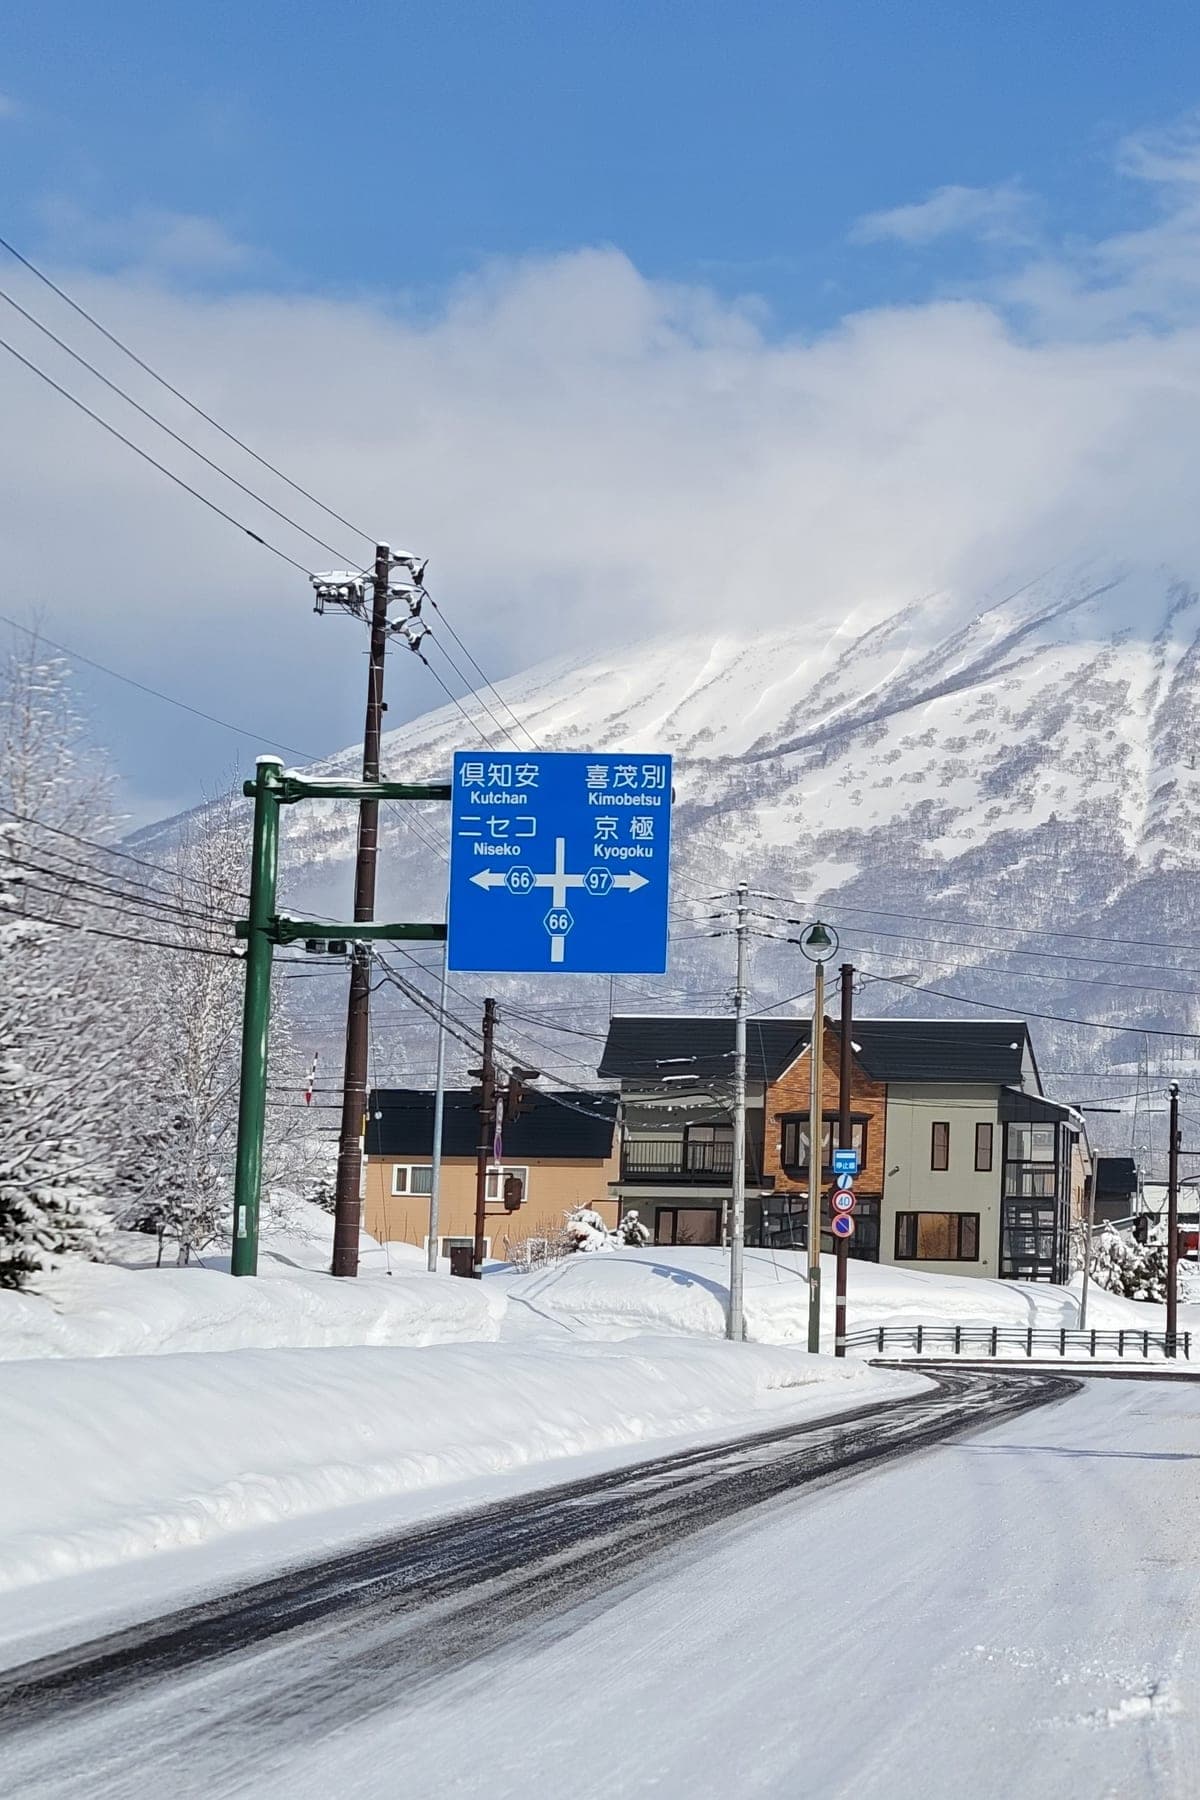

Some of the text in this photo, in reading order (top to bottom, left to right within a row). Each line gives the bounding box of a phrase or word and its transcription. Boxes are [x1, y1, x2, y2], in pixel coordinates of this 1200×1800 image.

[585, 764, 666, 789] 喜茂別
[470, 791, 527, 804] Kutchan
[588, 792, 661, 806] Kimobetsu
[458, 815, 537, 837] ニセコ
[474, 842, 521, 855] Niseko
[594, 843, 653, 859] Kyogoku
[510, 872, 530, 888] 66
[589, 873, 608, 889] 97
[549, 914, 568, 929] 66
[838, 1196, 850, 1206] 40
